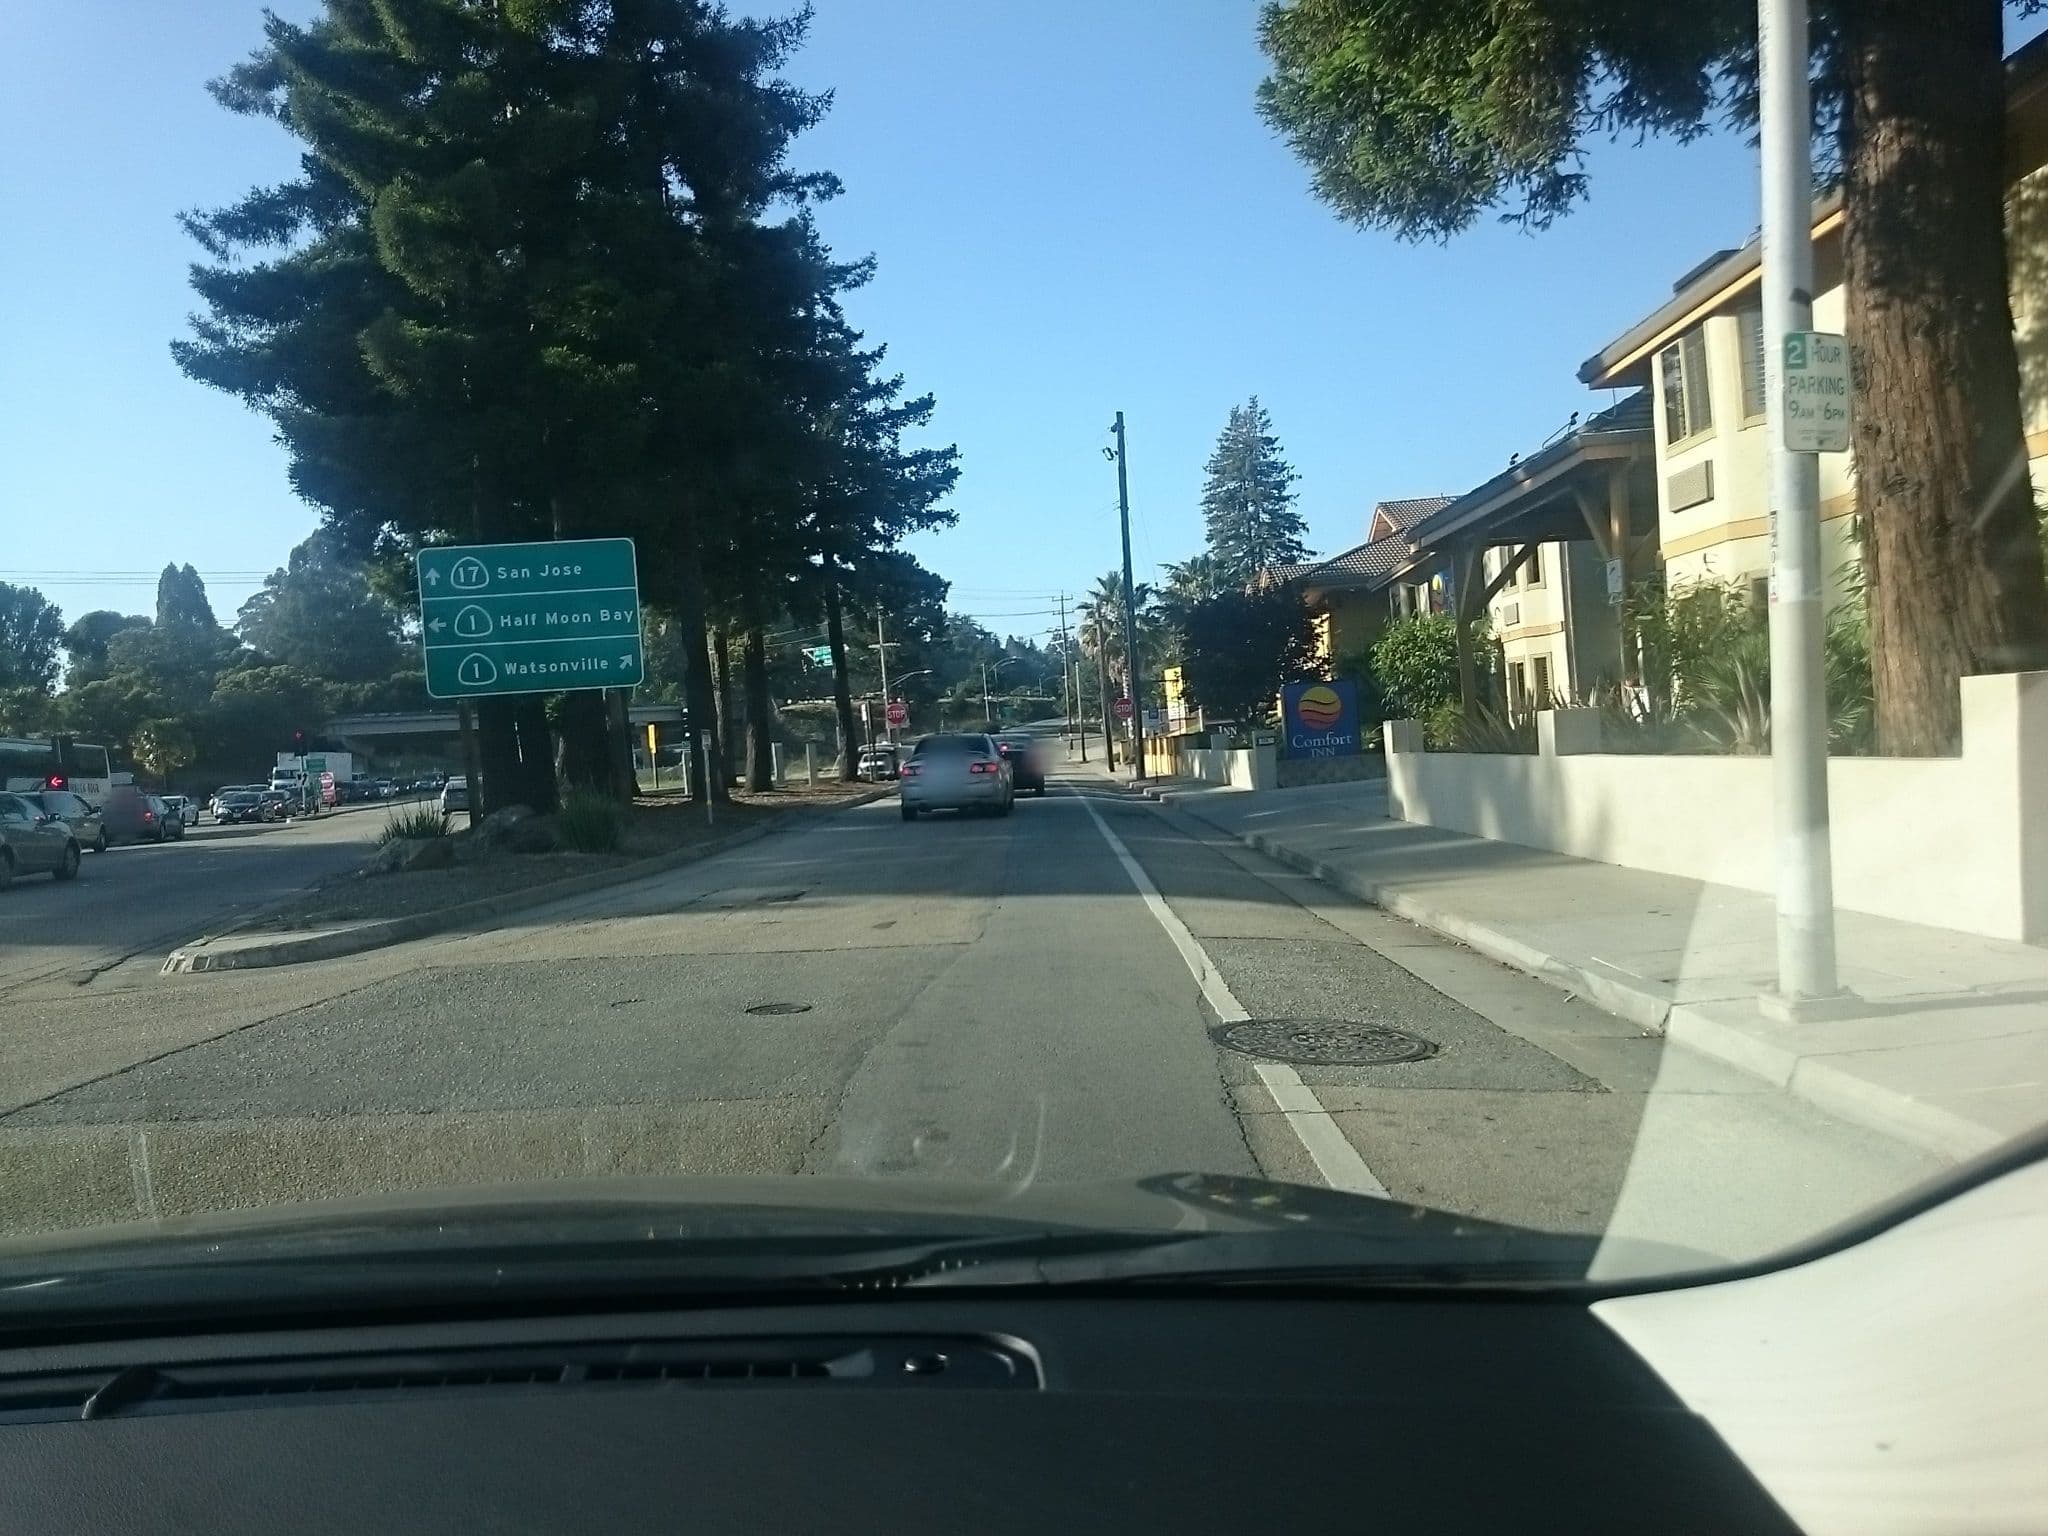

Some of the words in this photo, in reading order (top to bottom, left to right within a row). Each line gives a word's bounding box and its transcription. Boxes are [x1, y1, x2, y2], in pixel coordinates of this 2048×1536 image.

[1787, 340, 1803, 364] 2
[1812, 346, 1841, 362] HOUR
[1789, 376, 1845, 396] PARKING
[457, 566, 480, 584] 17
[497, 567, 531, 580] San
[539, 563, 583, 578] Jose
[468, 614, 477, 631] 1
[500, 613, 538, 628] Half
[545, 610, 592, 626] Moon
[600, 608, 634, 624] Bay
[472, 662, 481, 679] 1
[504, 657, 610, 676] Watsonville
[888, 709, 906, 719] STOP
[1292, 731, 1353, 748] Comfort
[1311, 748, 1336, 758] INN
